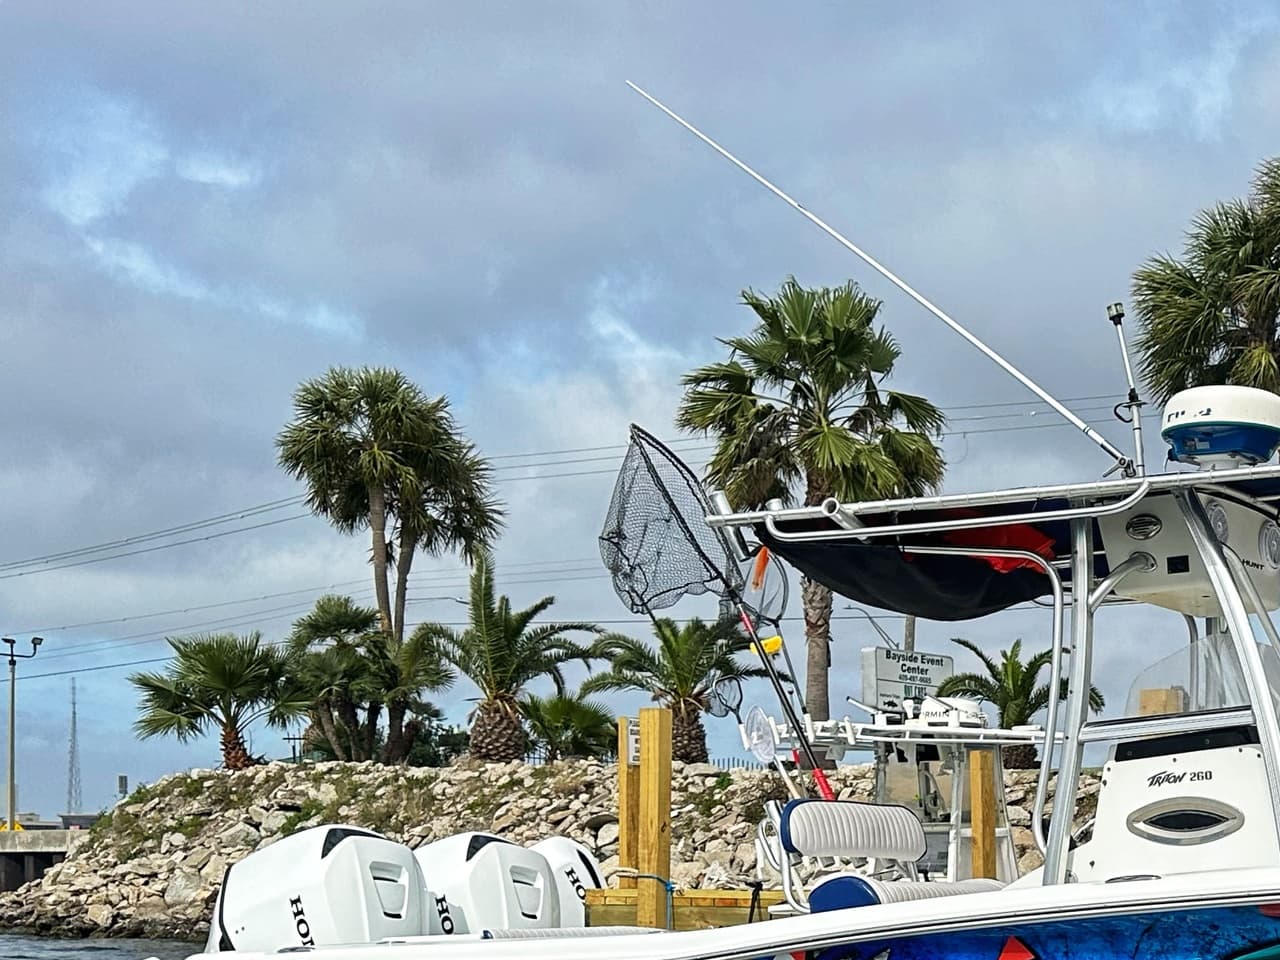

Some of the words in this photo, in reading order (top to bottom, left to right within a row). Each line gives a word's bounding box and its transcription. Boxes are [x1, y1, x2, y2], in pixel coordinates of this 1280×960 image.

[885, 649, 919, 663] Bayside
[920, 655, 944, 667] Event
[900, 663, 929, 676] Center
[1147, 770, 1187, 787] TRITON
[1189, 770, 1213, 782] 260
